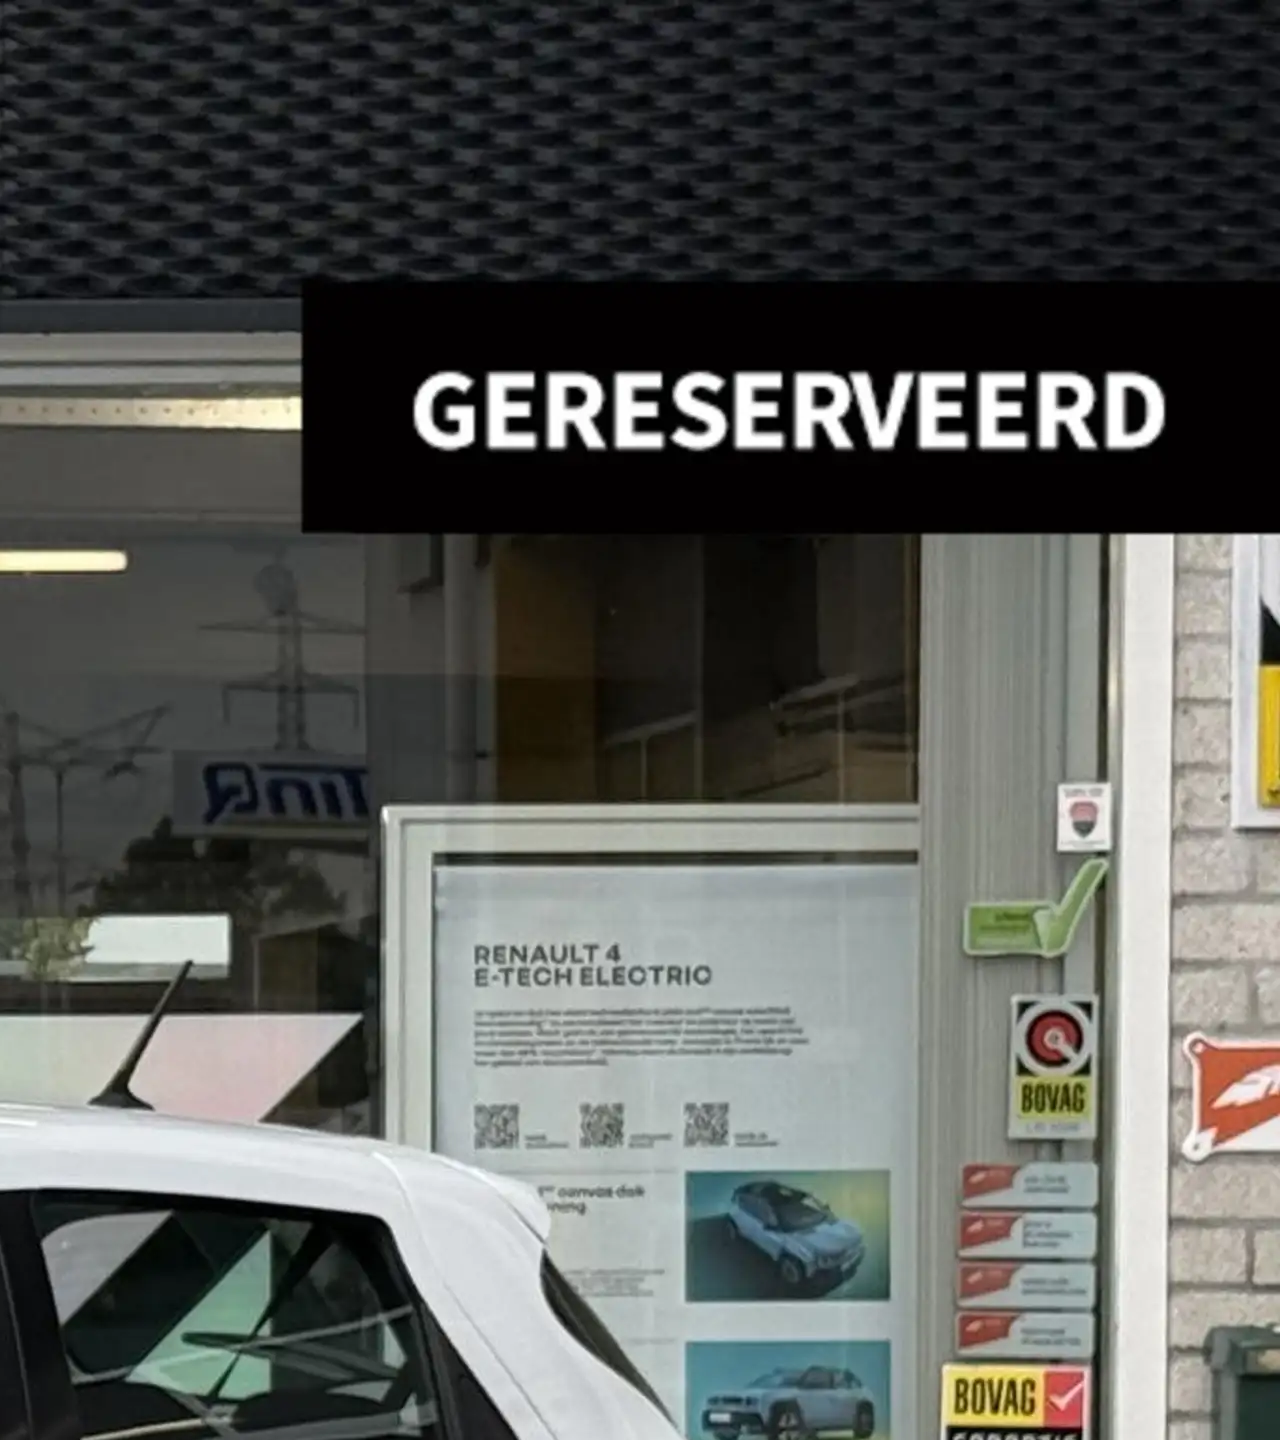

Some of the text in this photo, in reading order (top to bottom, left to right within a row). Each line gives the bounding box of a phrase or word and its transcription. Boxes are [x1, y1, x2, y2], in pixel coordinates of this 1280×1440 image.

[474, 943, 622, 965] RENAULT 4
[474, 965, 713, 987] E-TECH ELECTRIC
[1020, 1082, 1086, 1115] BOVAG
[953, 1378, 1036, 1415] BOVAG
